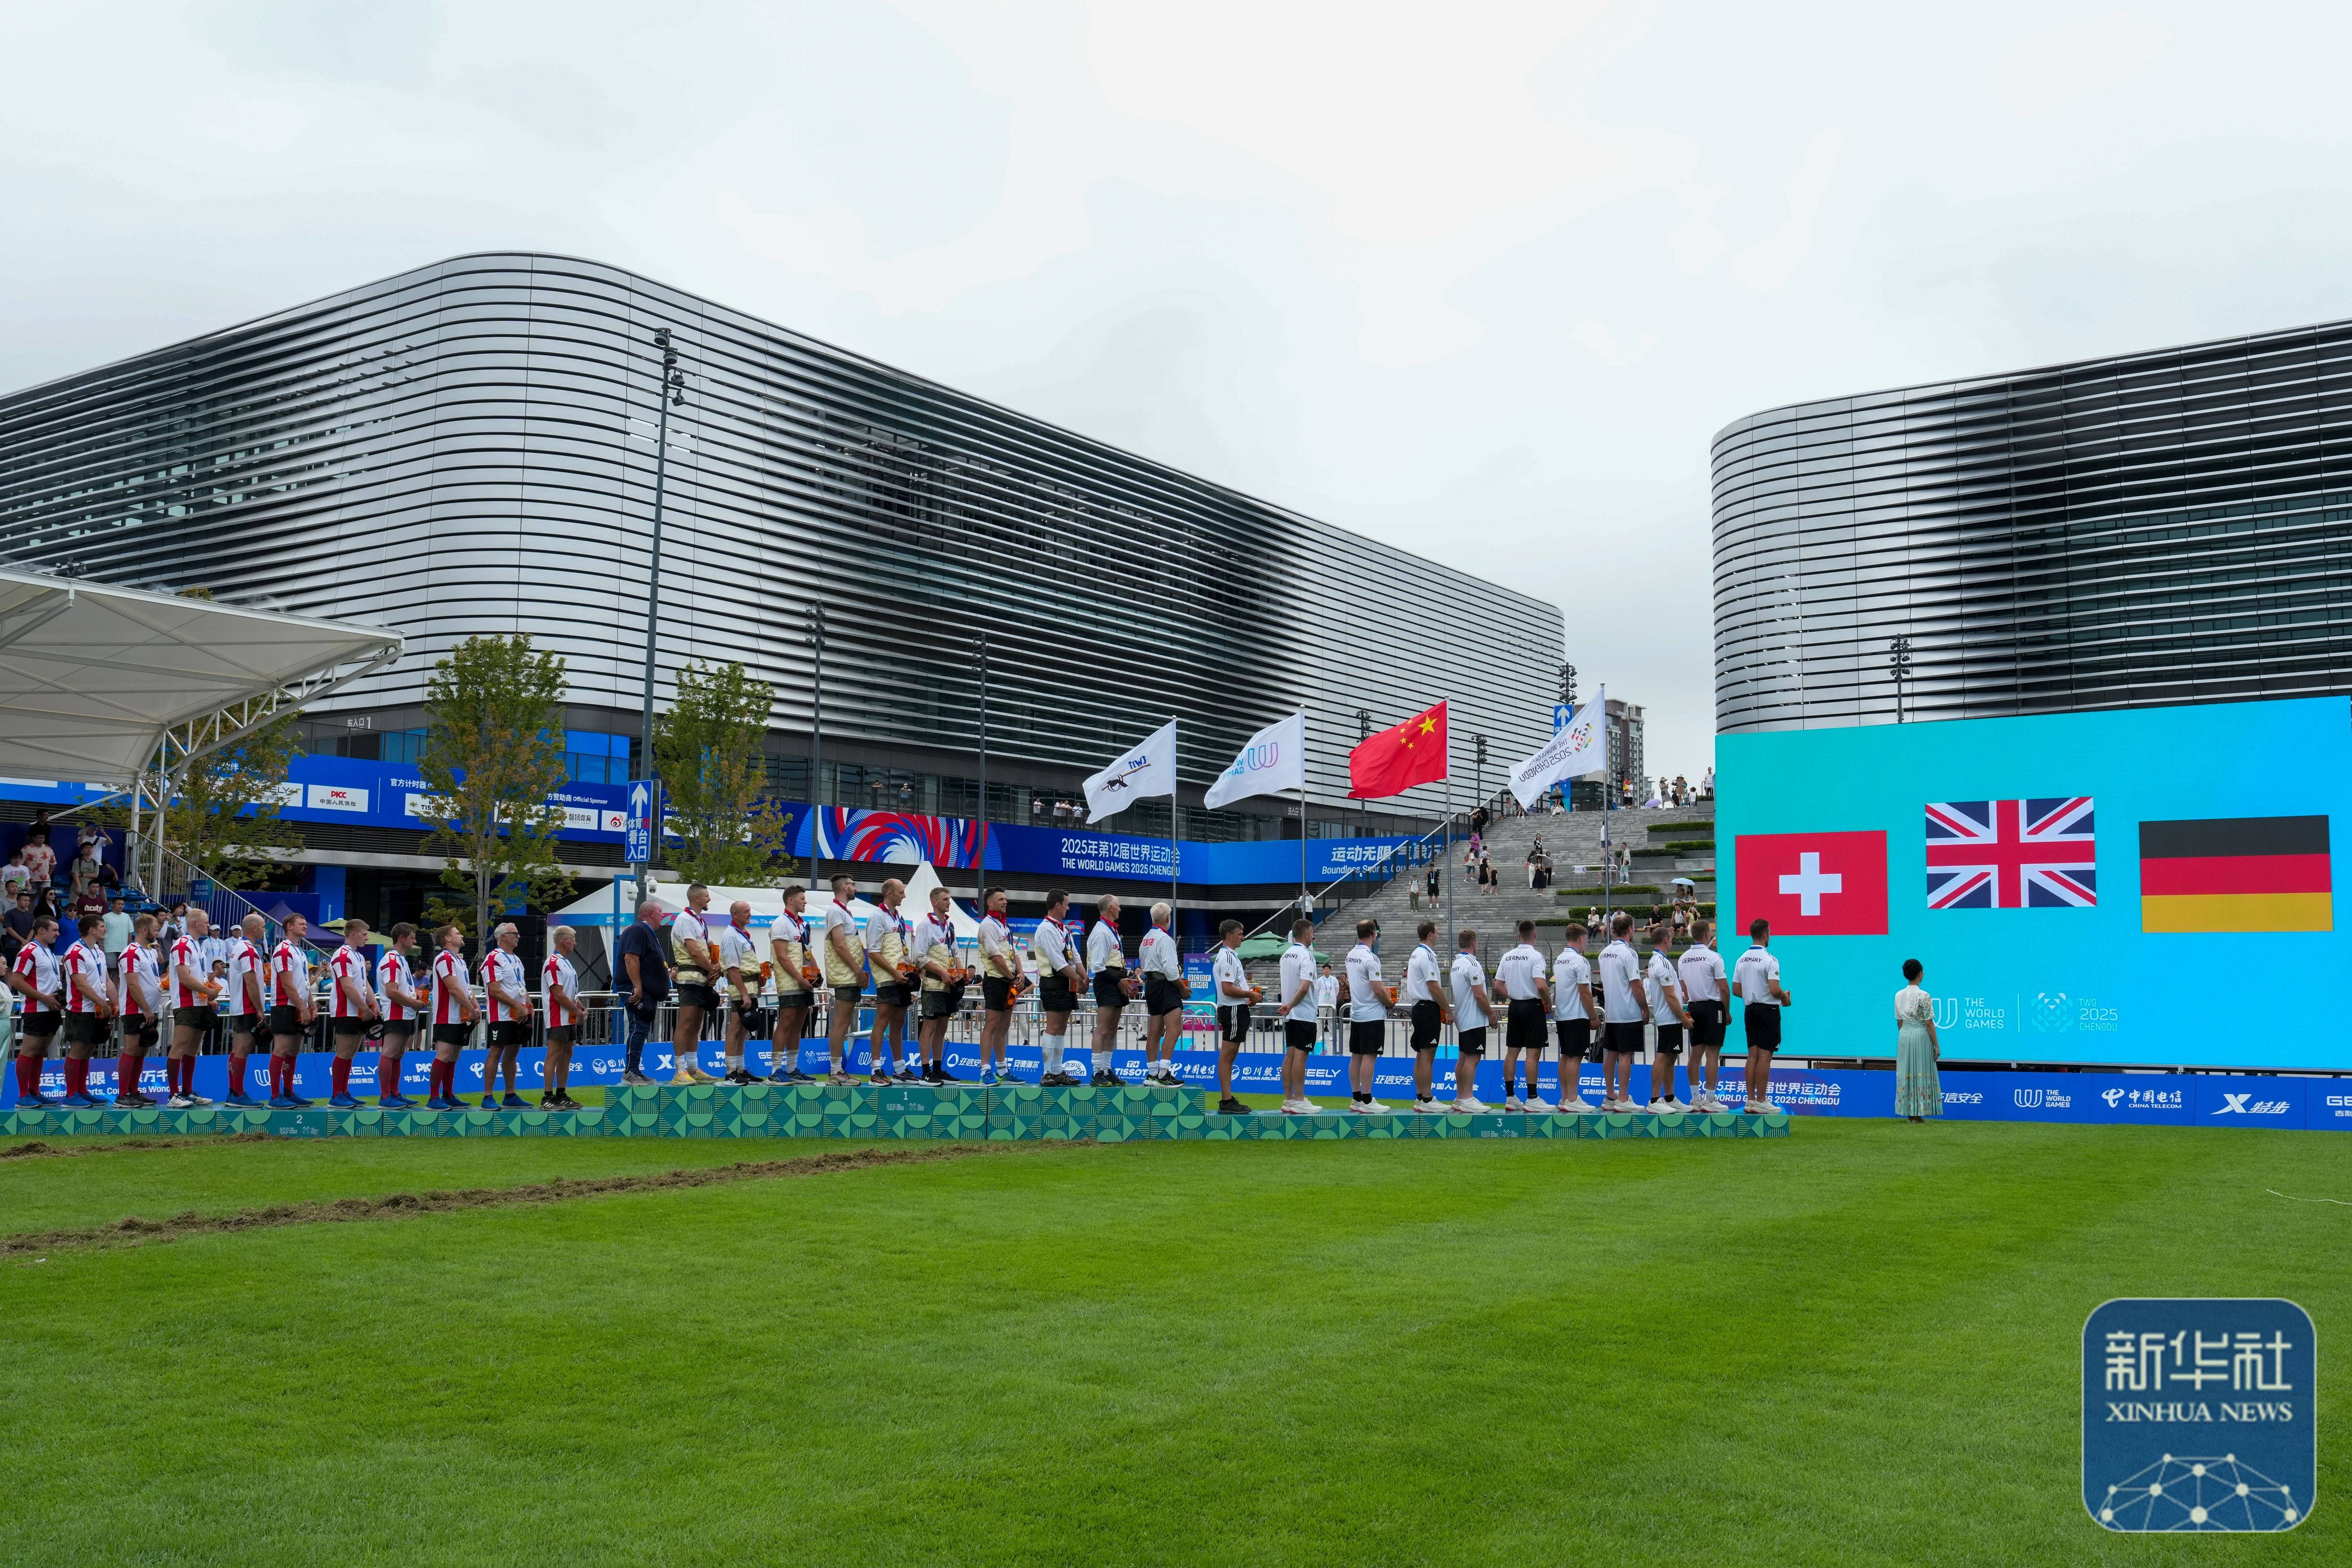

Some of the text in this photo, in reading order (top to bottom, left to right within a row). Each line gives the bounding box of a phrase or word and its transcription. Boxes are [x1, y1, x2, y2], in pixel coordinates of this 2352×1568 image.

[347, 718, 365, 727] 东入口
[390, 778, 426, 789] 官方计时器
[547, 793, 572, 802] 方赞助商
[628, 830, 647, 844] 看台
[628, 846, 647, 860] 入口
[1062, 838, 1180, 863] 2025年第12届世界运动会
[1062, 858, 1075, 869] THE
[1078, 859, 1103, 871] WORLD
[1105, 861, 1129, 873] GAMES
[1131, 863, 1148, 874] 2025
[1964, 998, 1985, 1007] THE
[1965, 1008, 2005, 1018] WORLD
[2080, 1008, 2118, 1020] 2025
[1965, 1019, 2004, 1029] GAMES
[2079, 1023, 2117, 1031] CHENGDU
[1013, 1059, 1040, 1068] 安德瑞尔
[1115, 1068, 1148, 1076] TISSOT
[1184, 1064, 1216, 1075] 中国电信
[1305, 1069, 1341, 1077] EELY
[1374, 1075, 1413, 1085] 亚信安全
[904, 1091, 908, 1100] 1
[2129, 1089, 2182, 1103] 中国电信
[1798, 1097, 1840, 1106] CHENGDU
[2247, 1101, 2290, 1114] 特步
[296, 1114, 302, 1123] 2
[1497, 1118, 1502, 1127] 3
